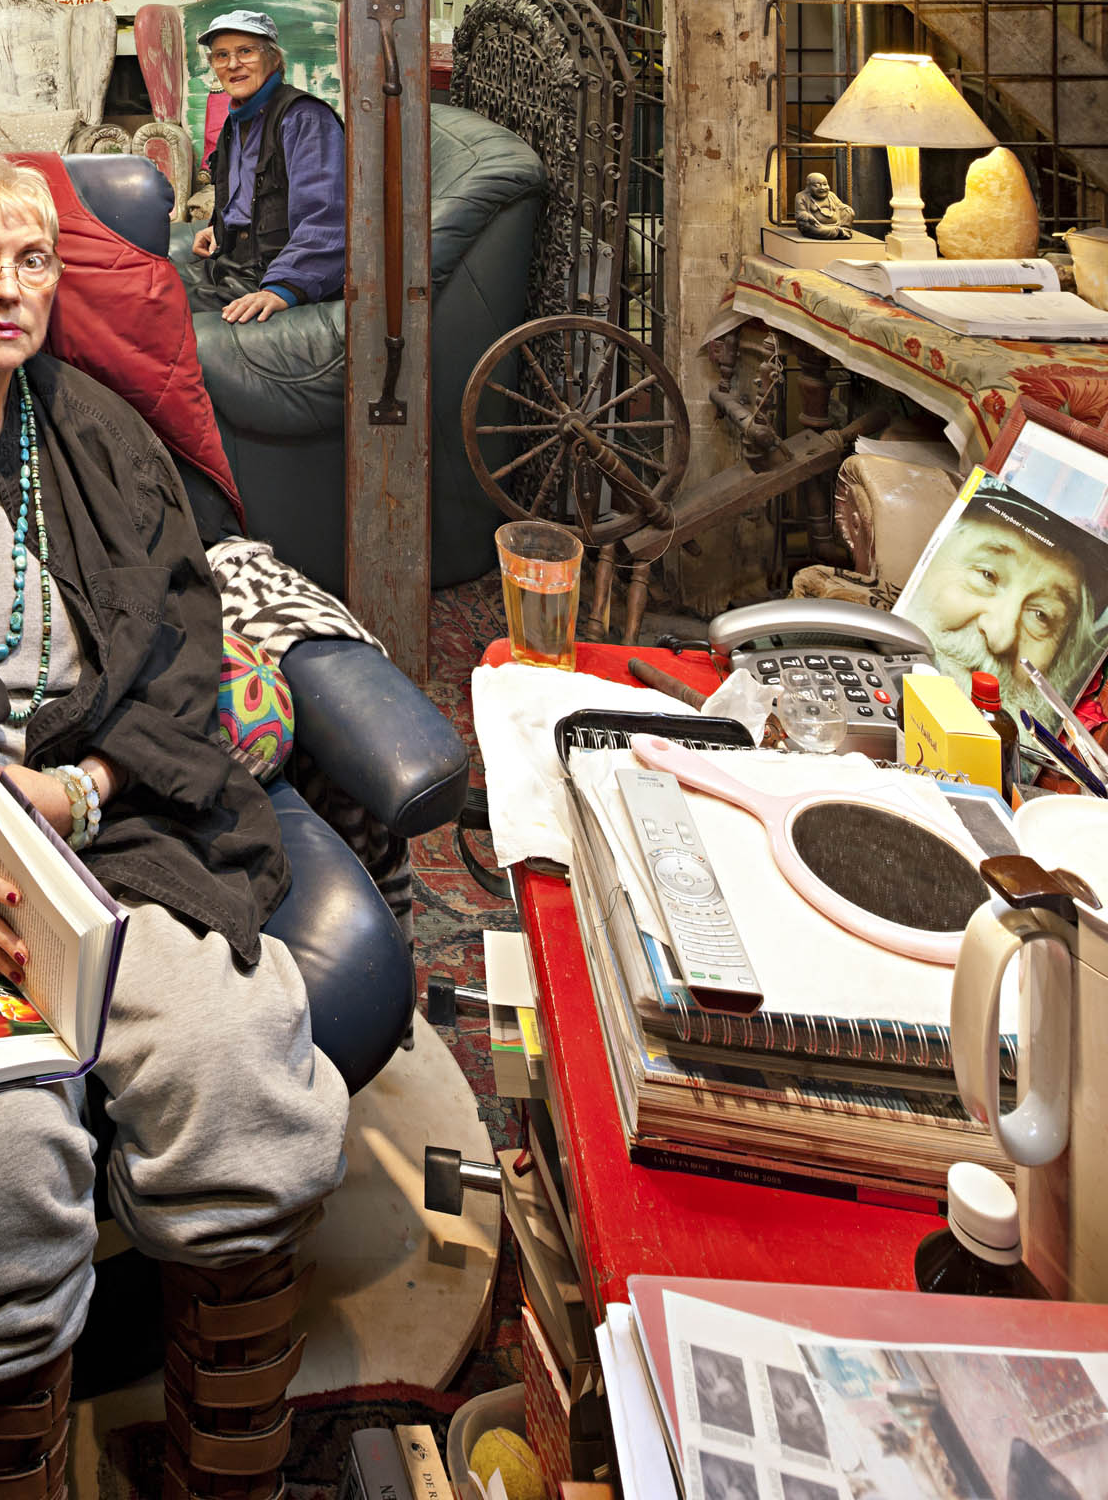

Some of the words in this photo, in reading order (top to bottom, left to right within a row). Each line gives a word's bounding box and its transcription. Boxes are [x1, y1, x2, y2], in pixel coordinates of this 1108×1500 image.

[985, 502, 1000, 515] Anton
[1001, 511, 1022, 527] Heyboer
[1025, 527, 1055, 547] zenmeester
[423, 1473, 436, 1489] DE
